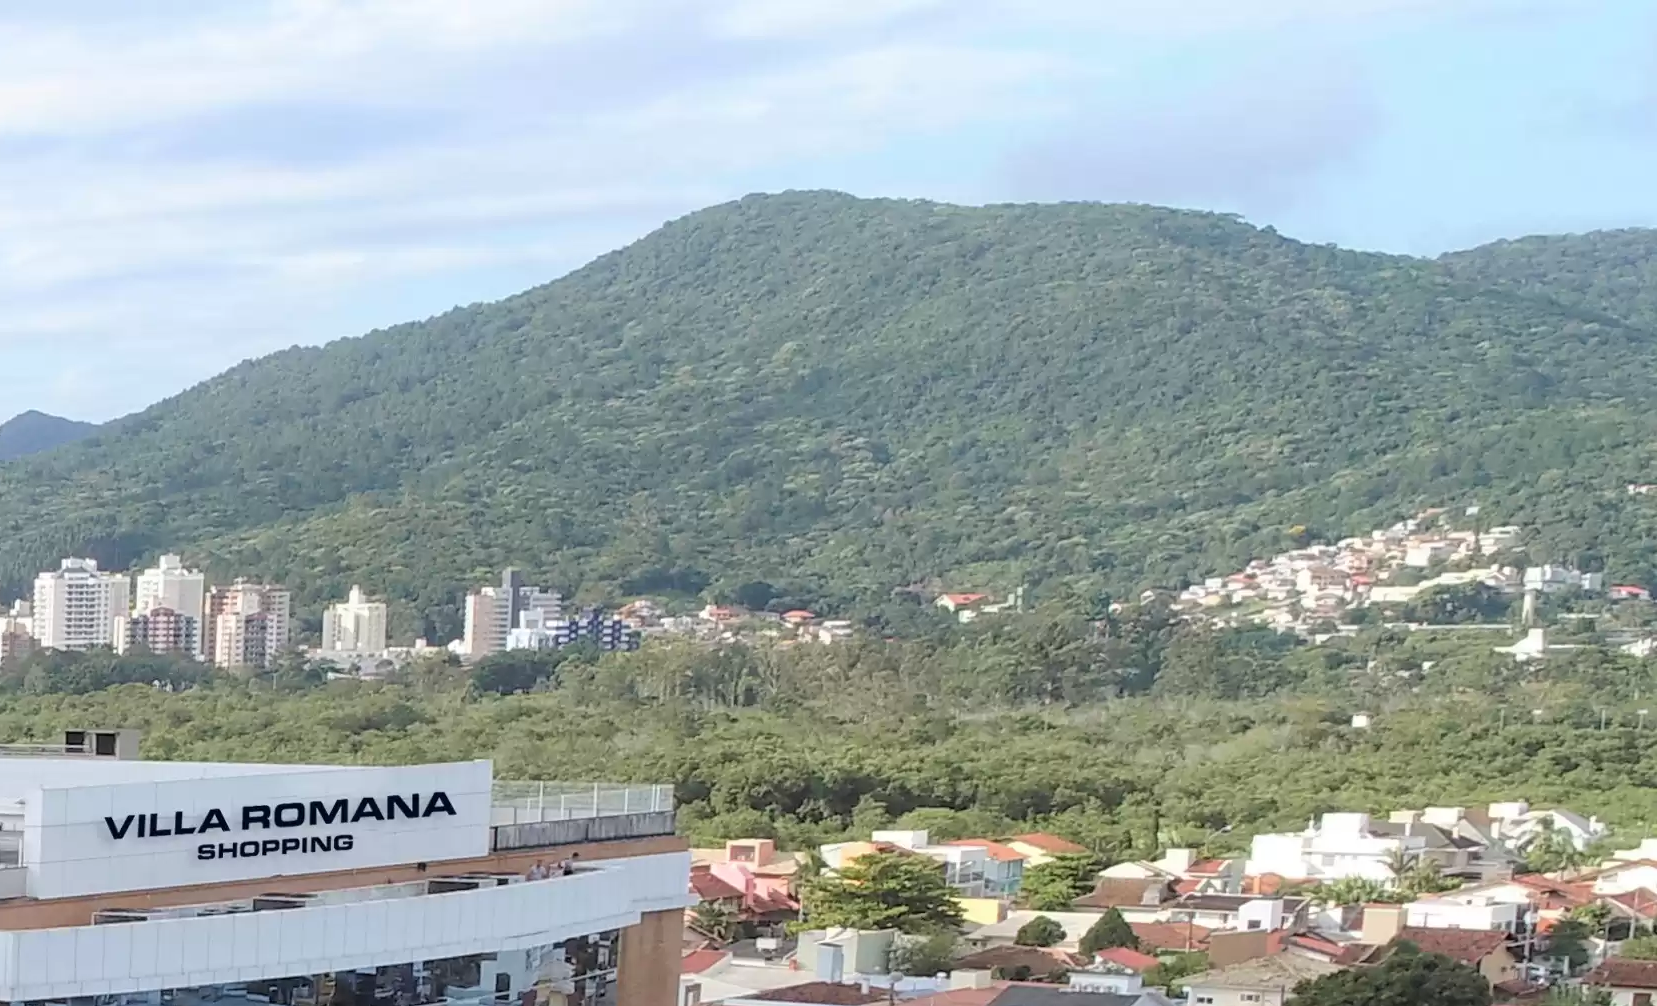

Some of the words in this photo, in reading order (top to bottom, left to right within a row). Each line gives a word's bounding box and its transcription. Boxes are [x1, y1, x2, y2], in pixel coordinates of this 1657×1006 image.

[104, 808, 231, 840] VILLA
[242, 791, 457, 830] ROMANA
[197, 834, 354, 860] SHOPPING
